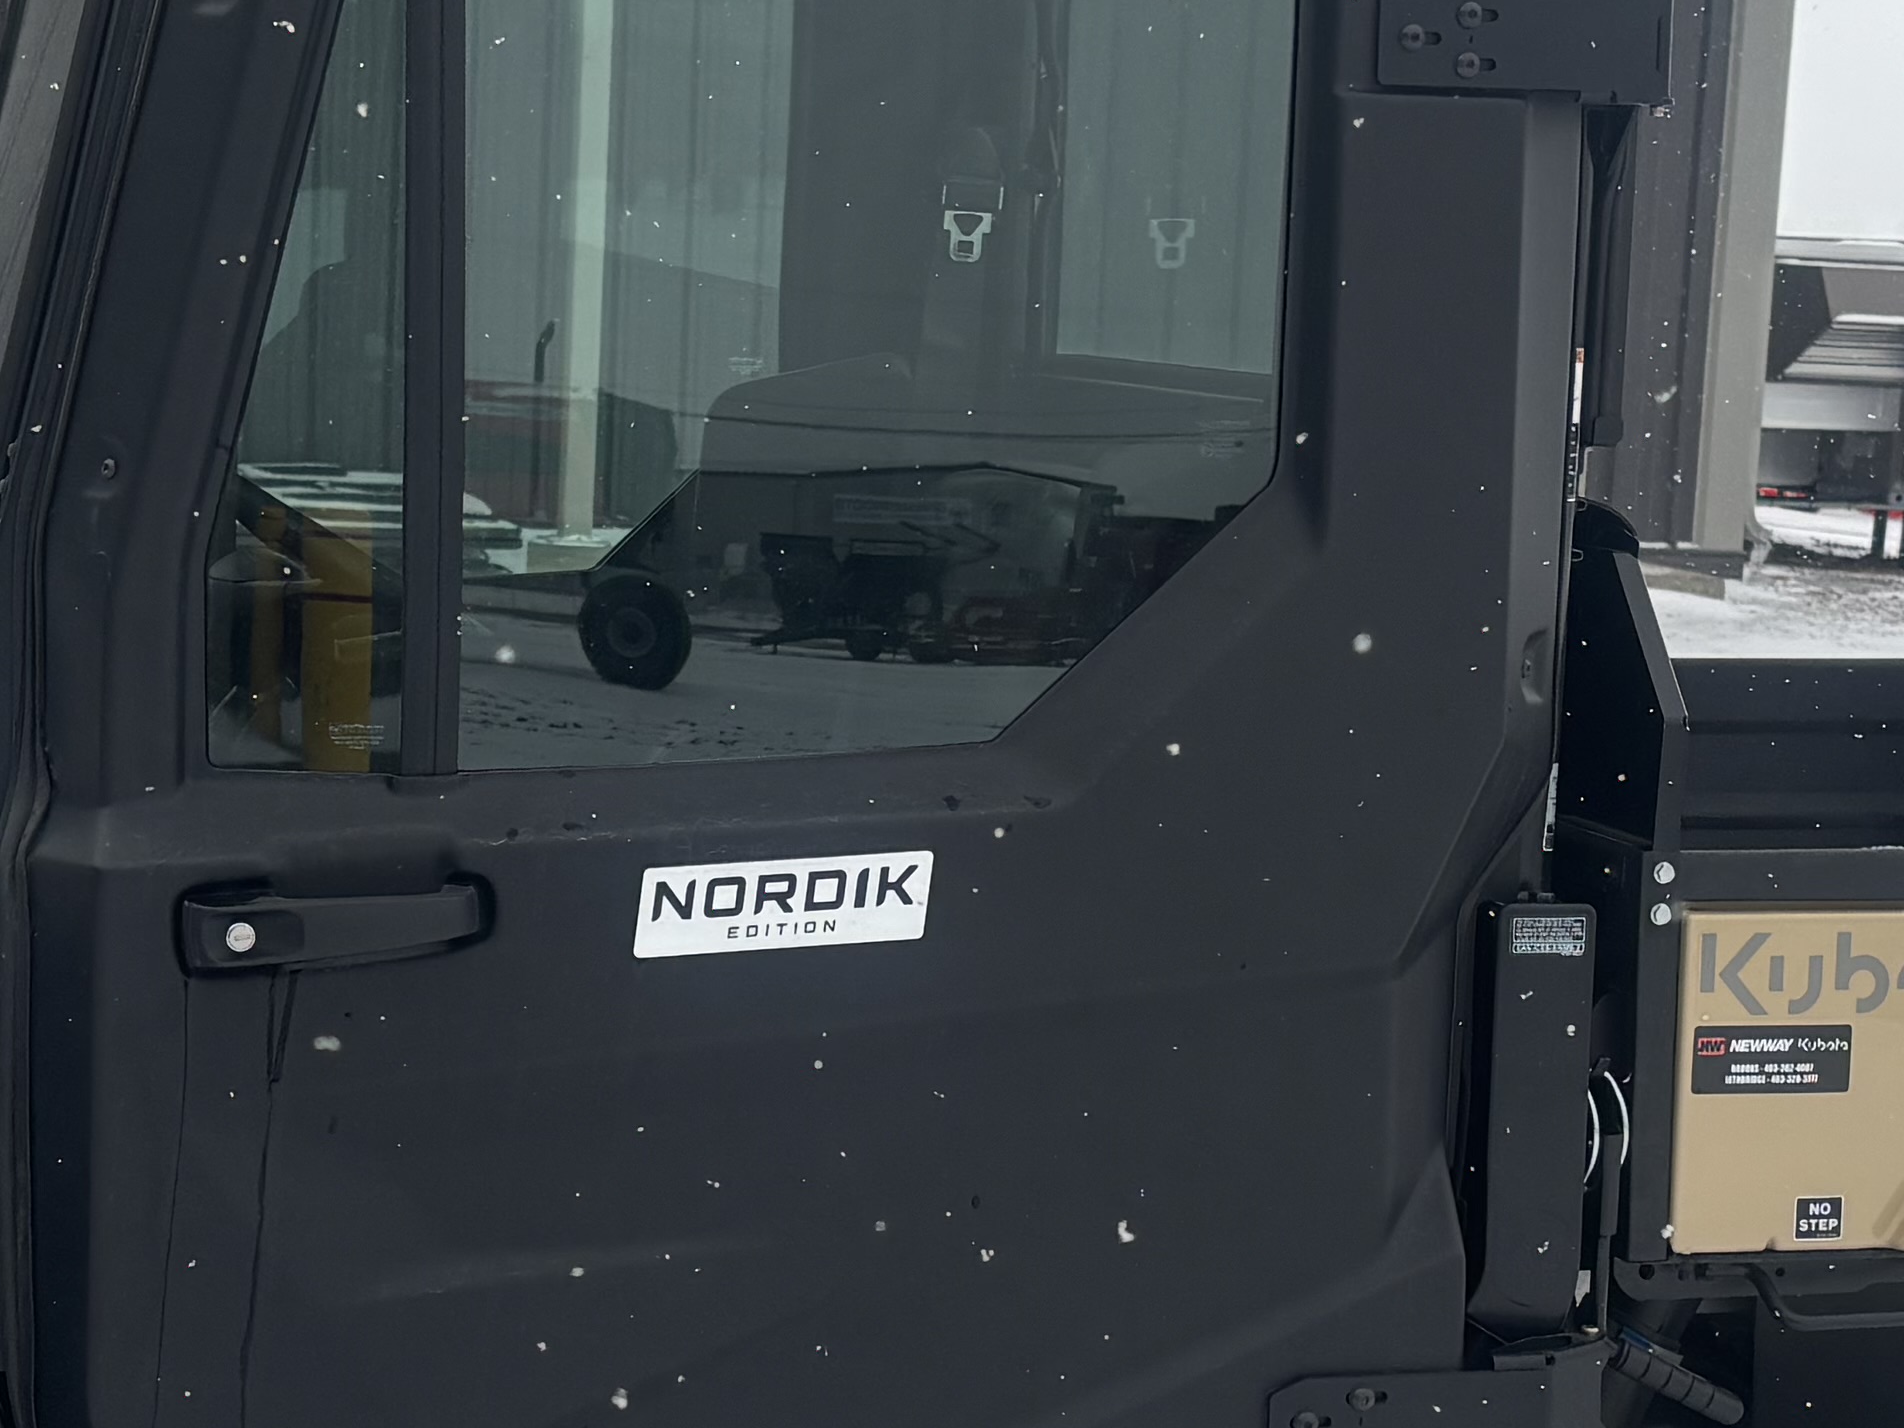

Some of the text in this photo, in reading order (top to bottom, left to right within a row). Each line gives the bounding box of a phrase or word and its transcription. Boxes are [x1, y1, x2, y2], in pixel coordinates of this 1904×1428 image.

[651, 864, 919, 922] NORDIK
[727, 919, 837, 939] EDITION
[1729, 1038, 1794, 1053] NEWWAY
[1797, 1037, 1849, 1052] Kubota
[1809, 1202, 1831, 1215] NO
[1799, 1218, 1839, 1232] STEP
